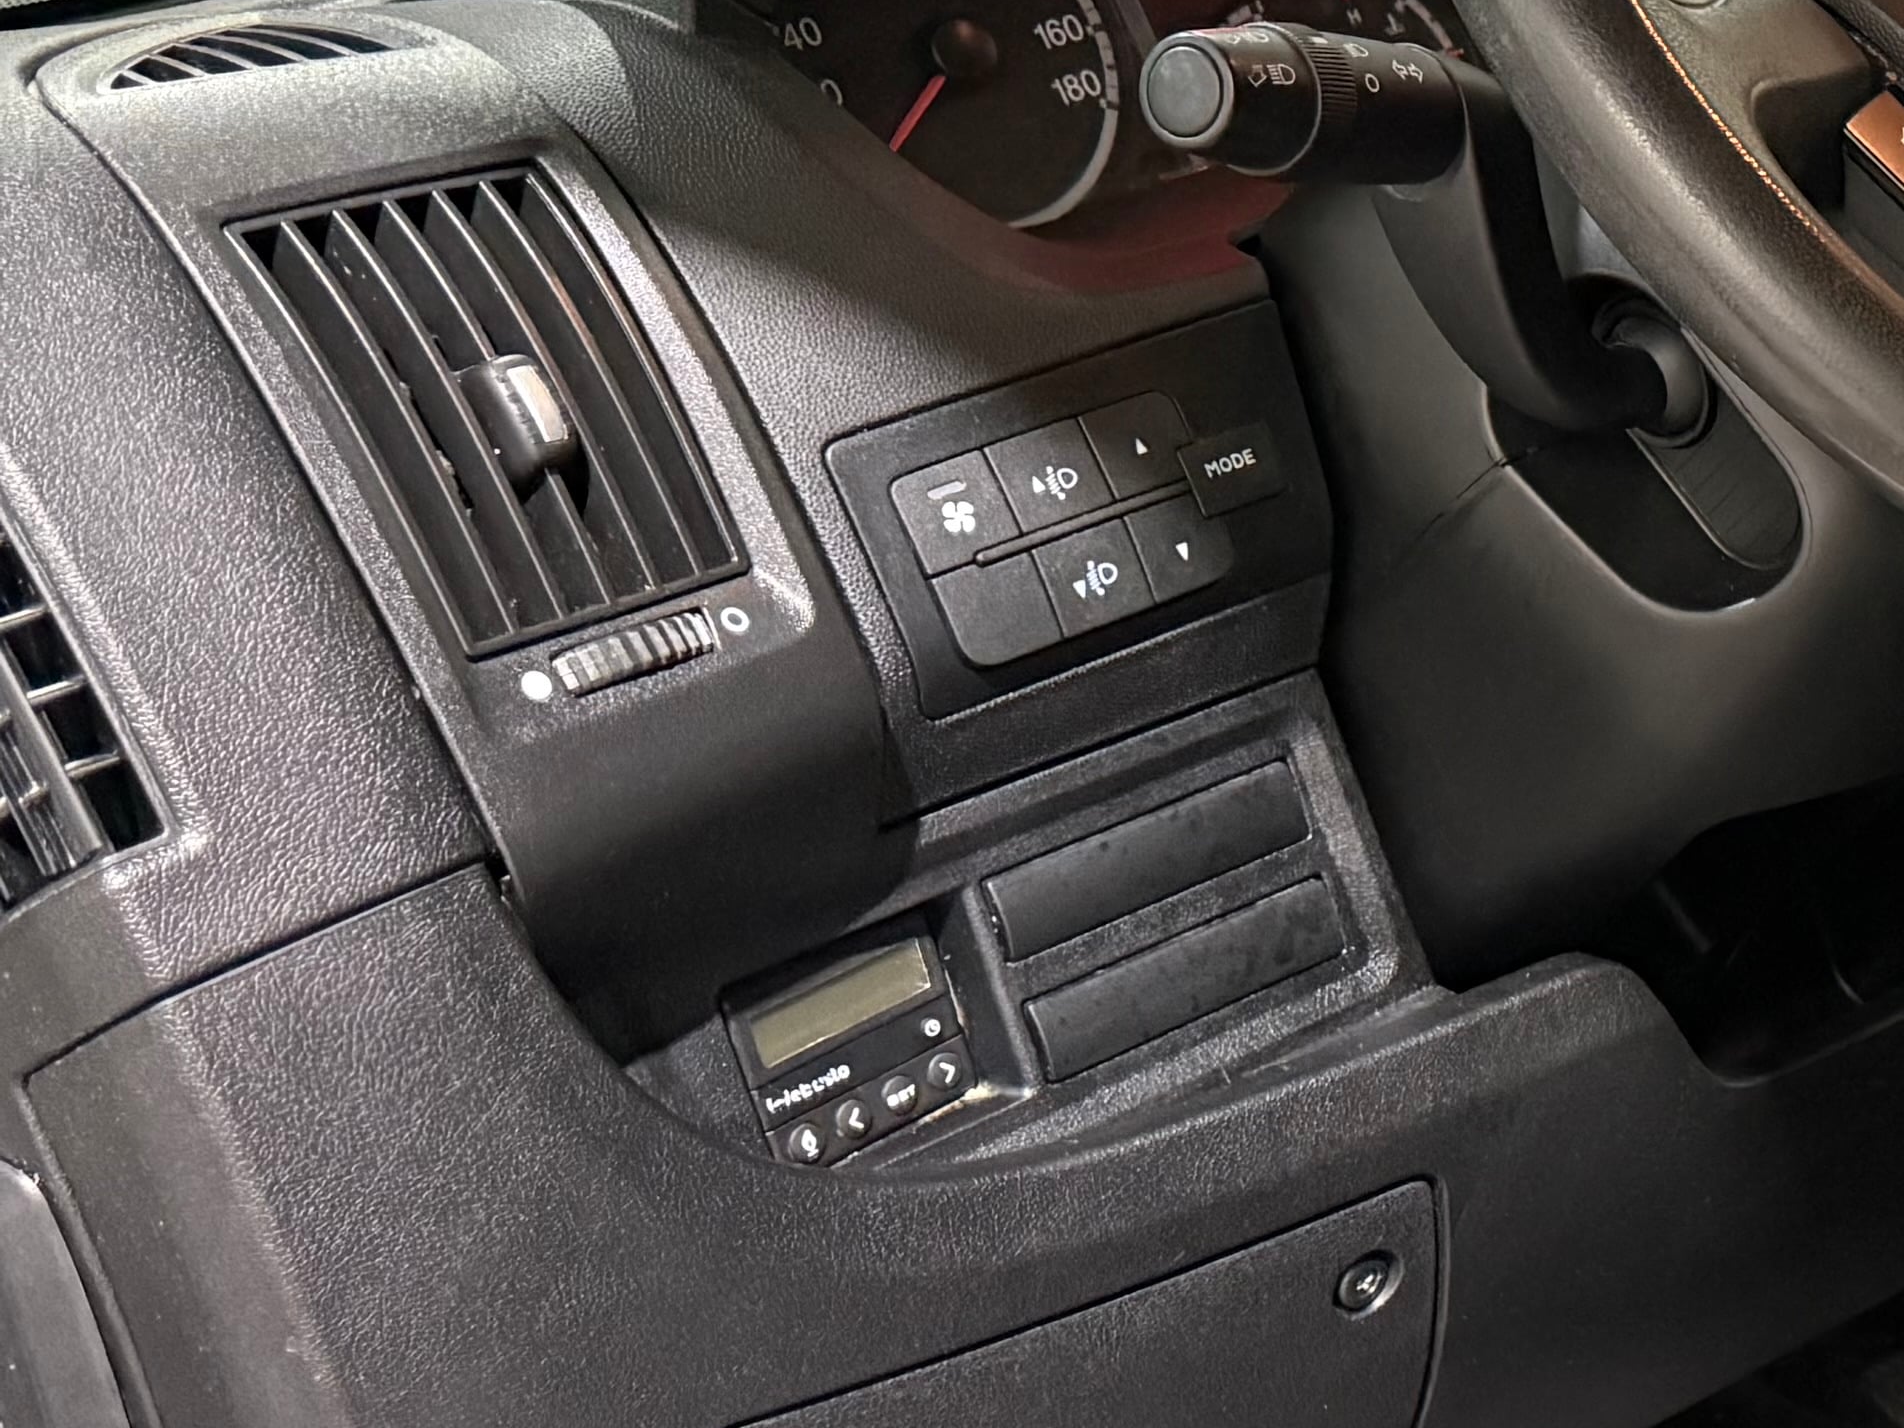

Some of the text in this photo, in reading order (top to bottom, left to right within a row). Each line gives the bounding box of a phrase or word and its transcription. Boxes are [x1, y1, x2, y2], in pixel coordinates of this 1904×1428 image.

[783, 17, 822, 50] 40
[1033, 14, 1085, 49] 160
[1051, 69, 1101, 106] 180
[1203, 448, 1256, 478] MODE
